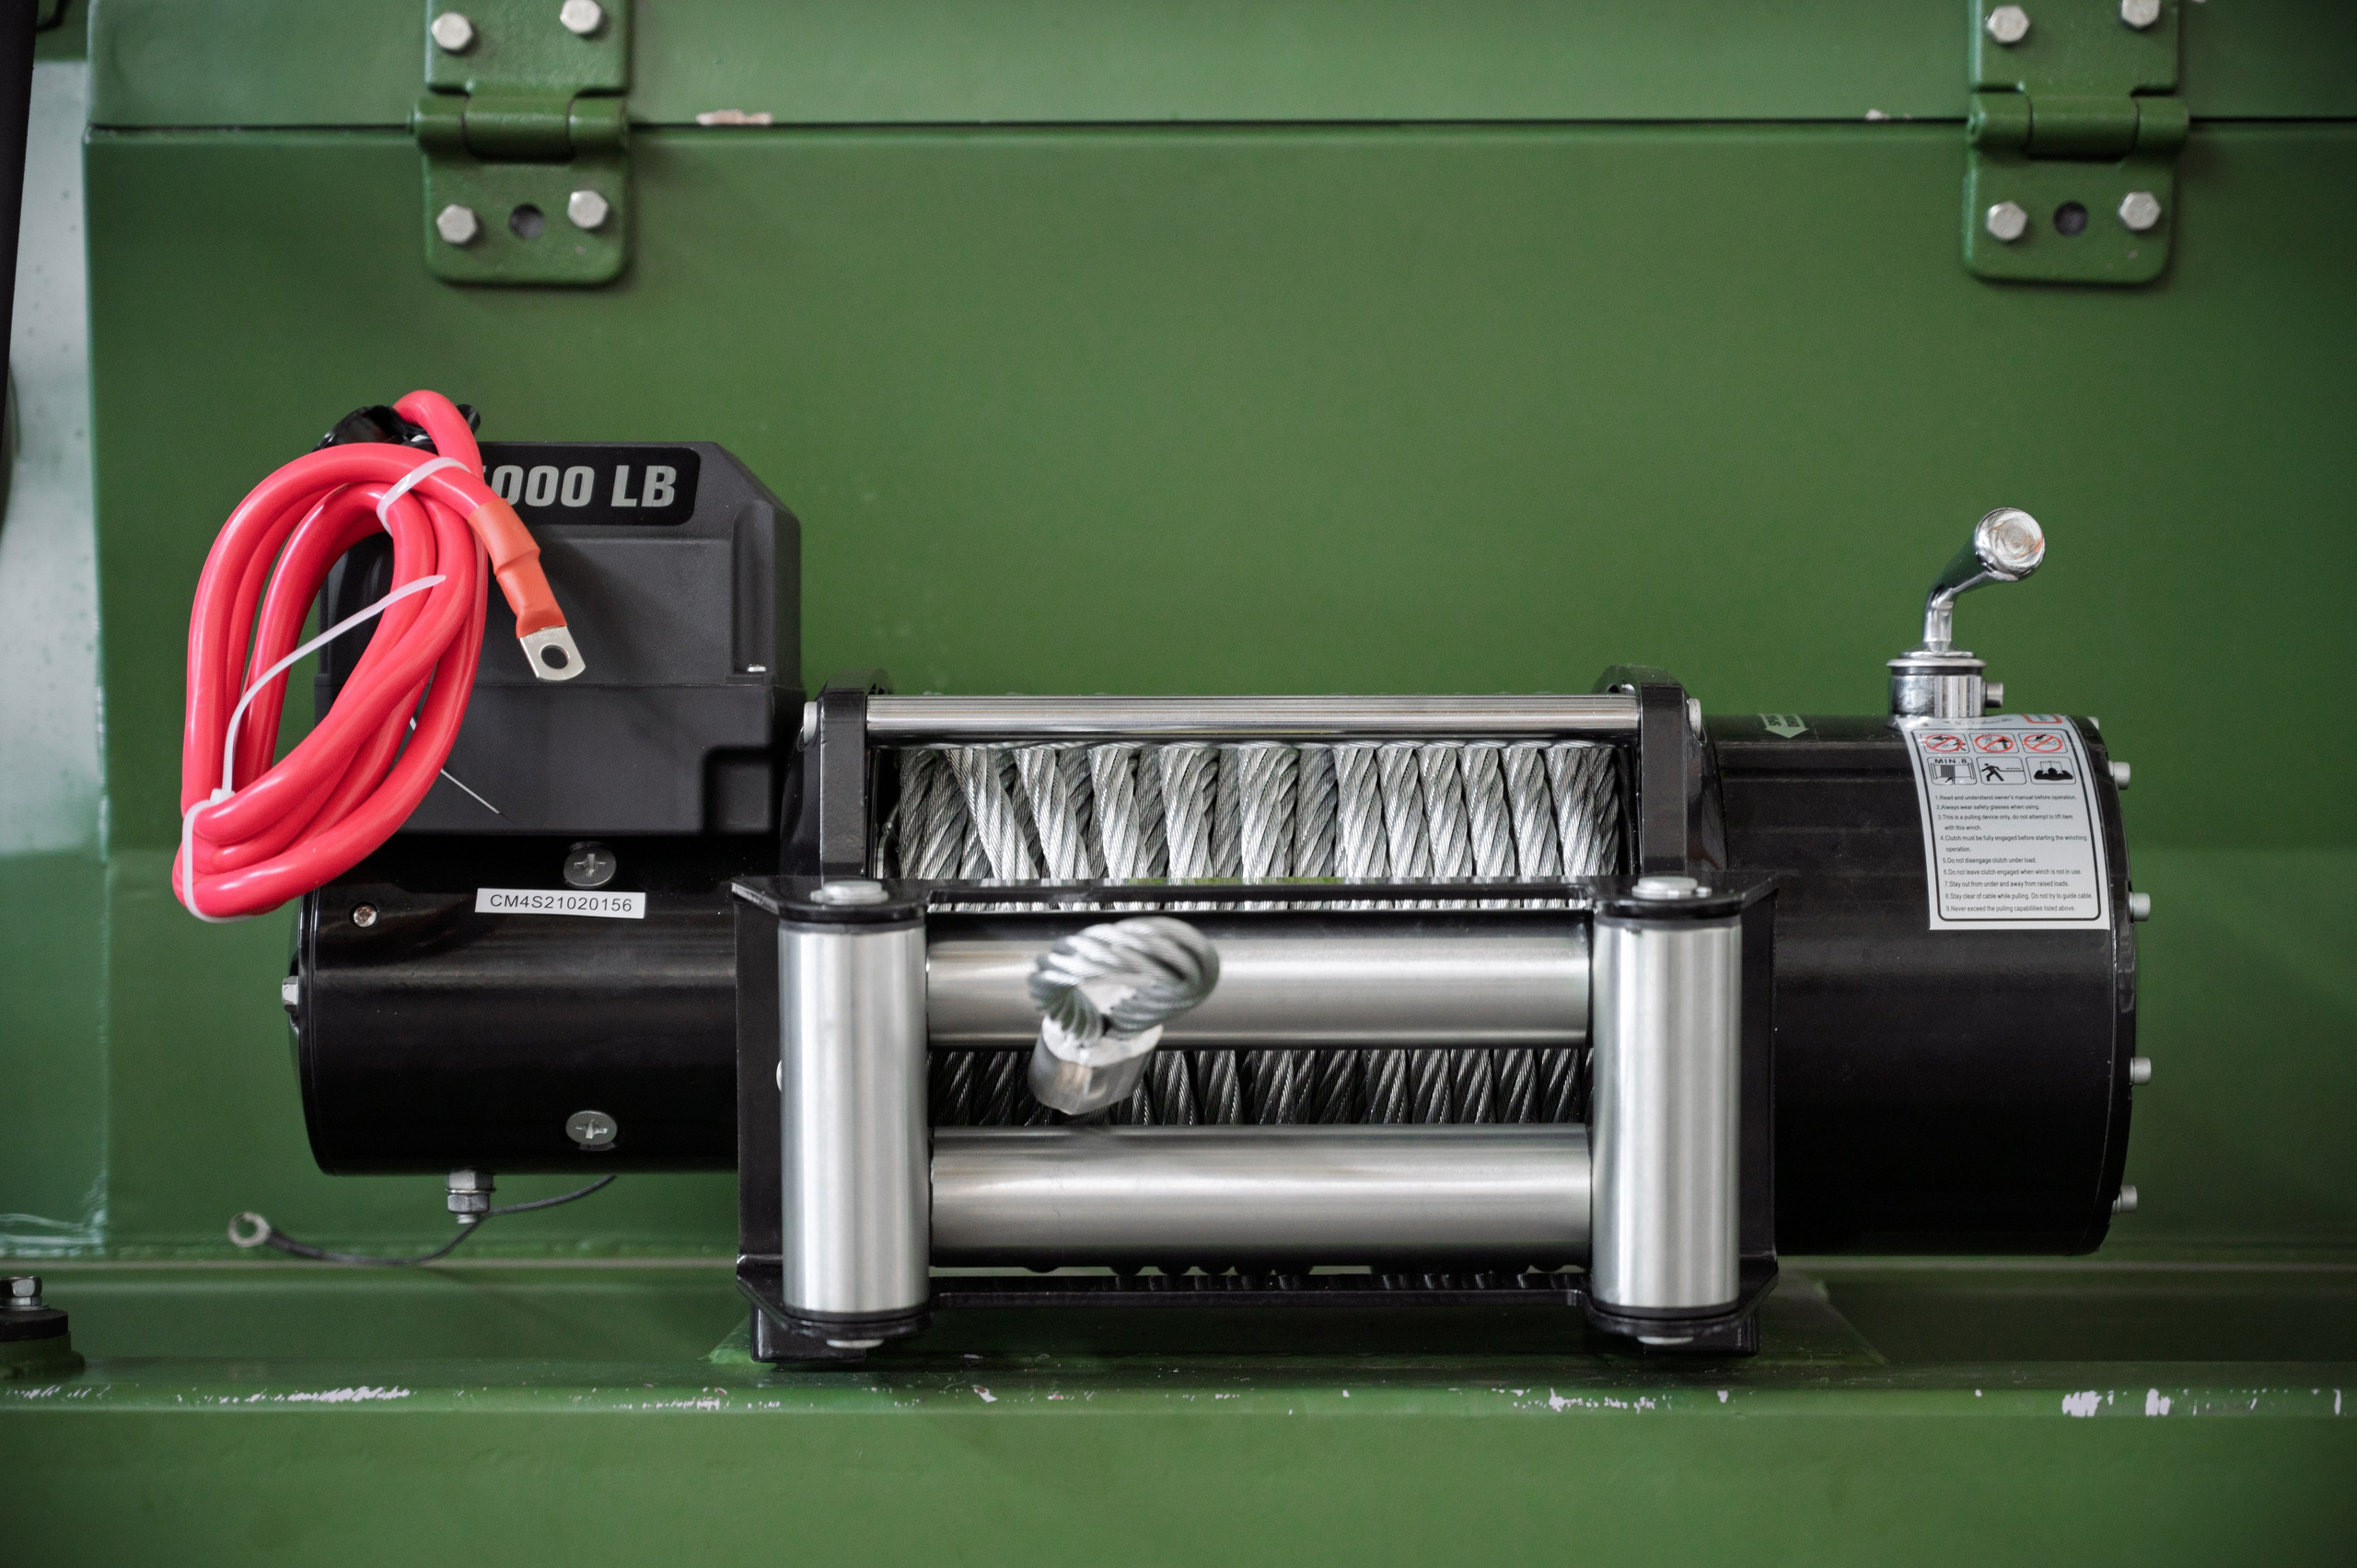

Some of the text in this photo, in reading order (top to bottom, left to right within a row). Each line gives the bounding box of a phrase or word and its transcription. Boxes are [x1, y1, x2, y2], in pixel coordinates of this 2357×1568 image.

[483, 465, 677, 507] 000 LB
[490, 893, 633, 912] CM4S21020156
